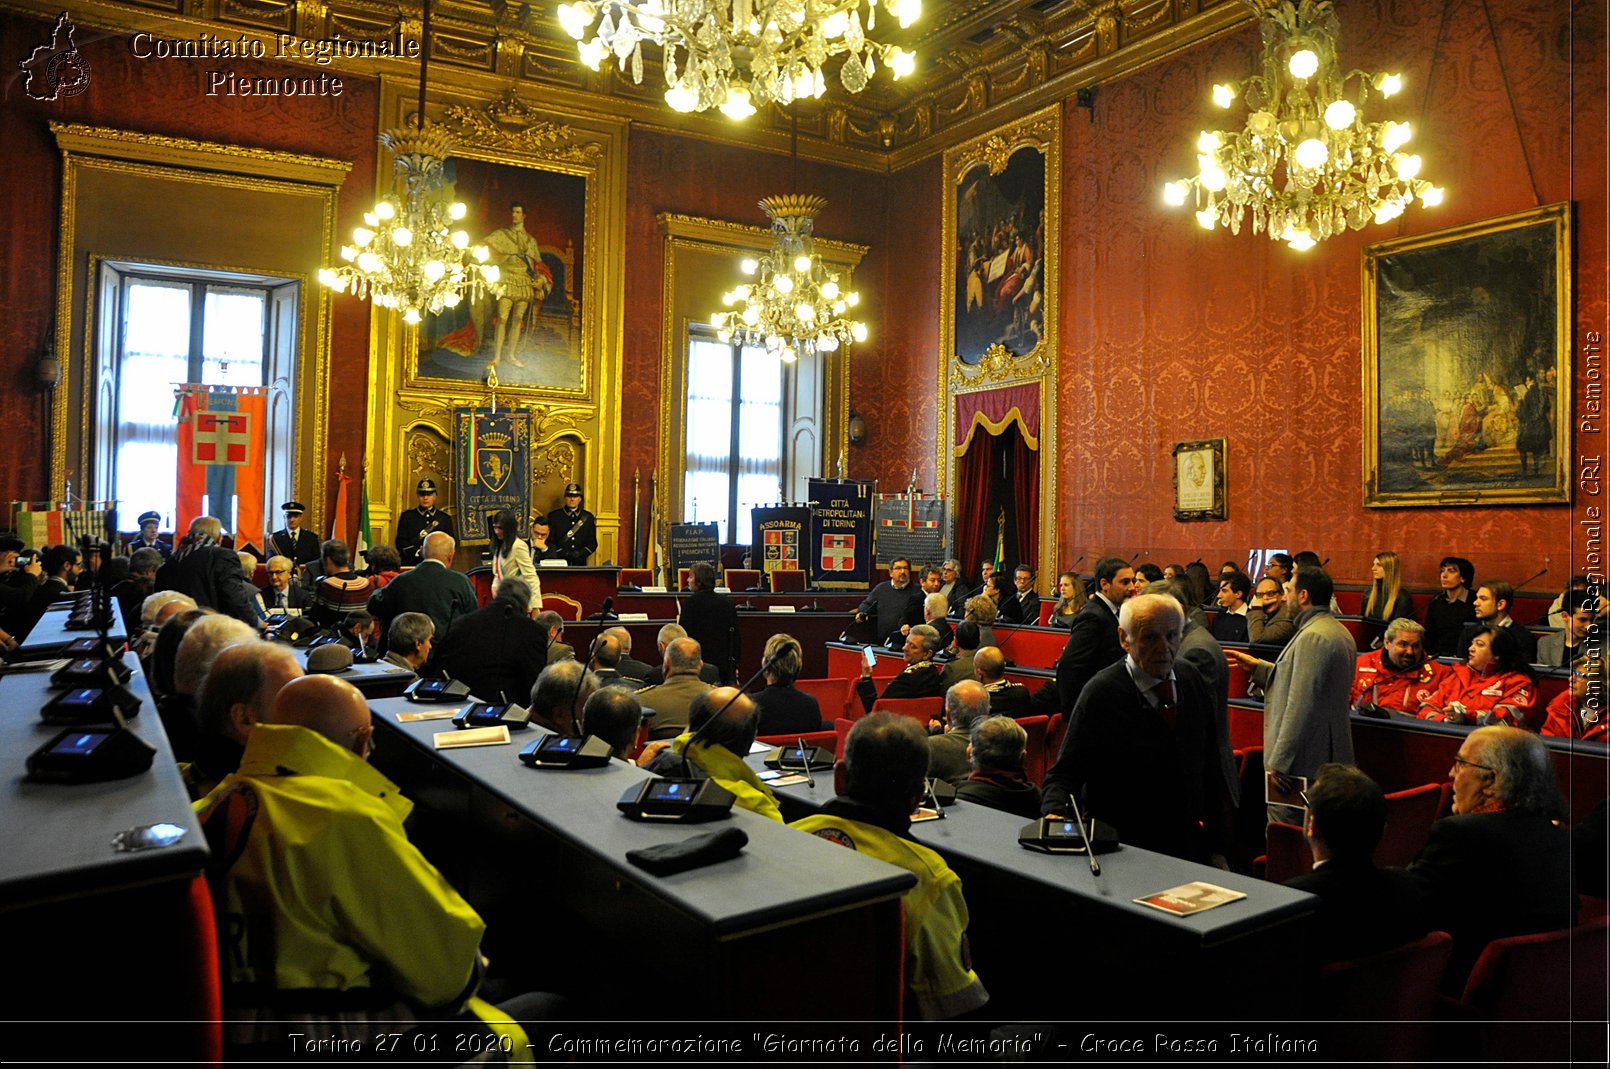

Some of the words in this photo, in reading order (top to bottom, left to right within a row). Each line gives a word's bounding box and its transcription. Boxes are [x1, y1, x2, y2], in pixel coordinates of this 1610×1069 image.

[831, 499, 849, 508] CITTÀ
[760, 520, 802, 531] ASSOARMA
[832, 520, 856, 529] TORINO
